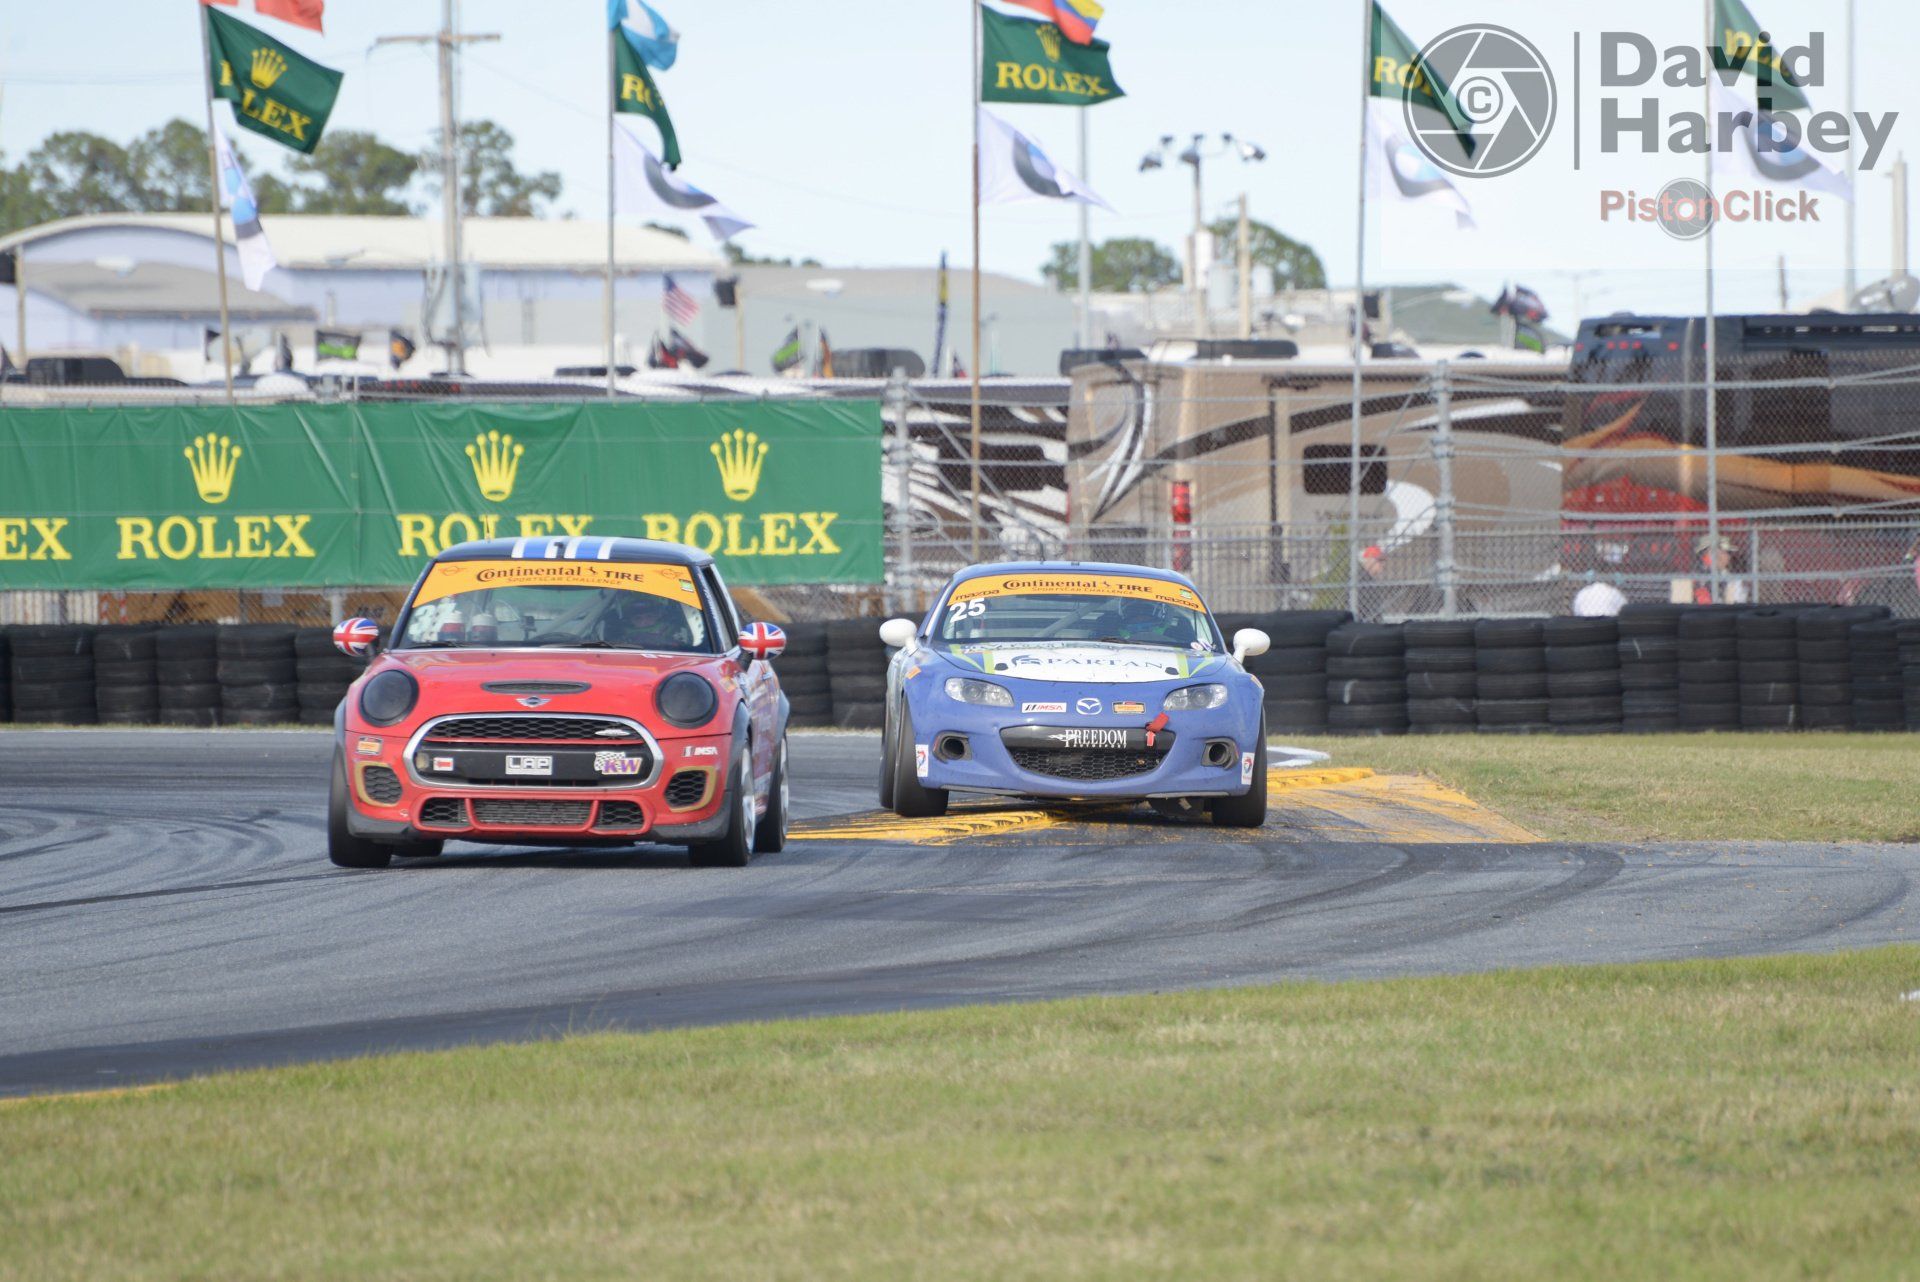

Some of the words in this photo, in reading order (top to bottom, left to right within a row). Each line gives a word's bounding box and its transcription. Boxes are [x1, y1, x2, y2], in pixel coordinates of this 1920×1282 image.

[995, 61, 1110, 96] ROLEX
[116, 515, 315, 560] ROLEX
[476, 566, 581, 582] Continental
[604, 570, 644, 583] TIRE
[1003, 580, 1097, 590] Continental
[1116, 583, 1153, 593] TIRE
[949, 597, 986, 623] 25
[1064, 729, 1128, 747] FREEDOM
[604, 758, 640, 775] KW
